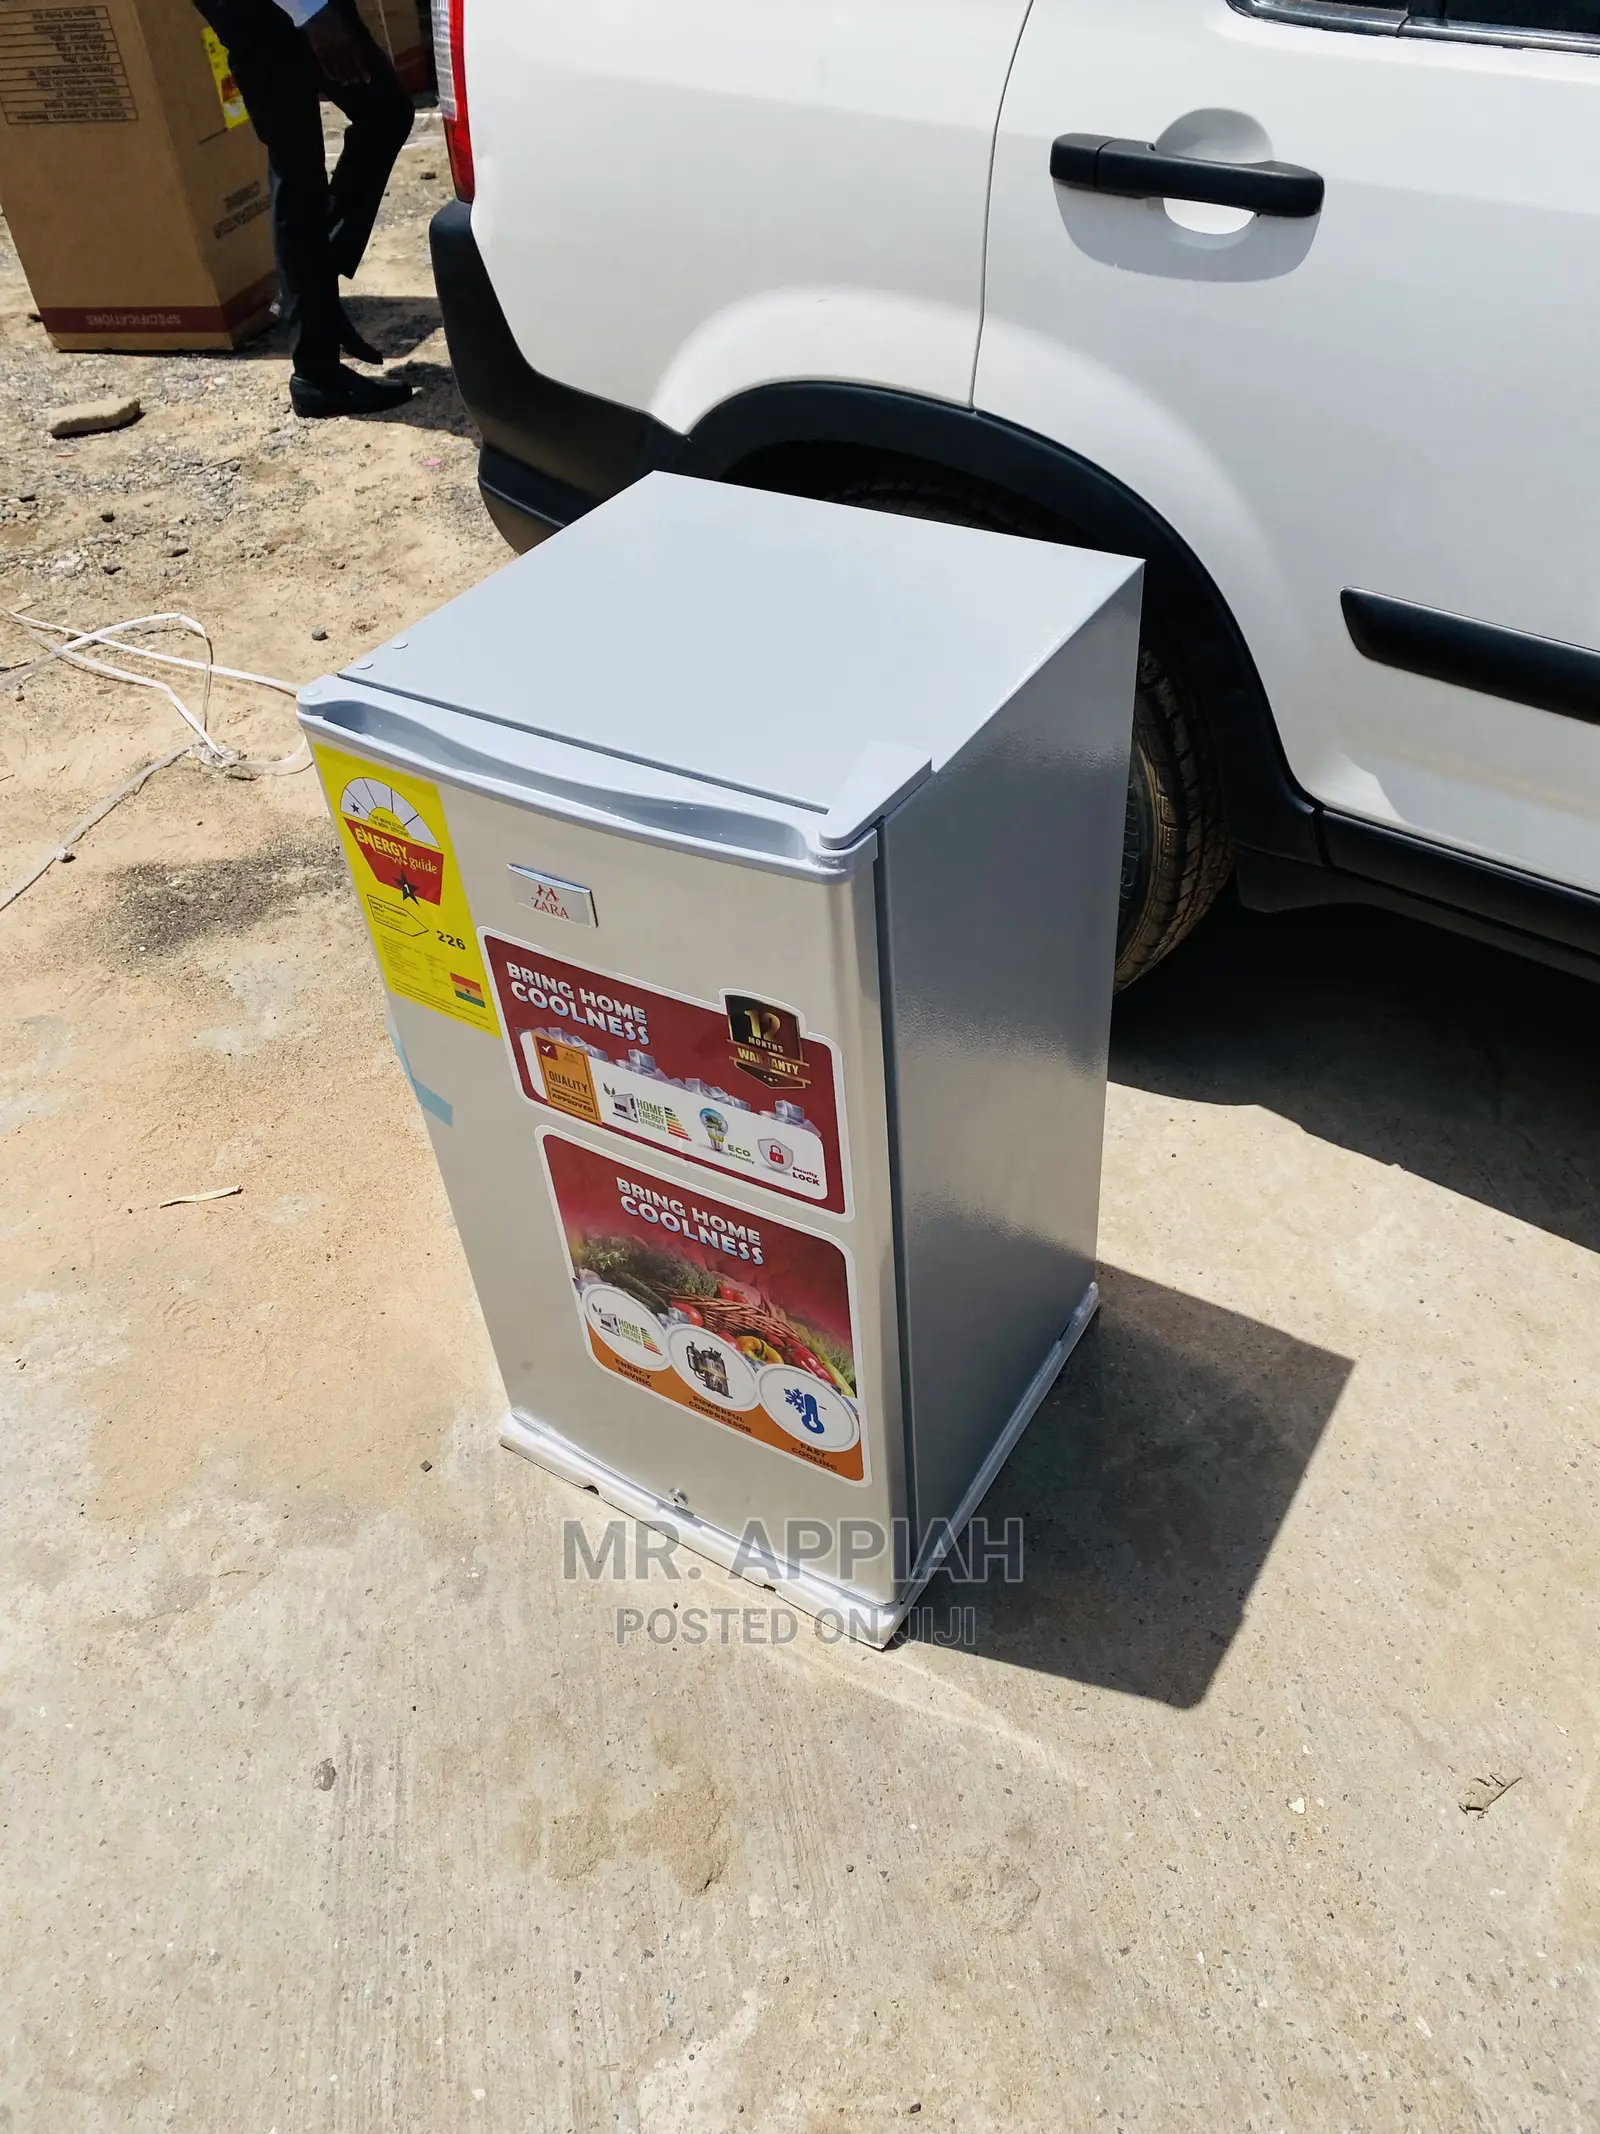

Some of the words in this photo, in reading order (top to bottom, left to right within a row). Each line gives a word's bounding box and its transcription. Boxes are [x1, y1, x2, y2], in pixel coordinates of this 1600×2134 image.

[86, 314, 181, 327] SPECIFICATIONS
[354, 826, 408, 860] ENERGY
[409, 857, 438, 874] guide
[531, 897, 569, 919] ZARA
[436, 930, 466, 950] 226
[505, 961, 575, 1000] BRING
[579, 987, 648, 1025] HOME
[510, 981, 649, 1045] COOLNESS
[744, 1009, 781, 1041] 12
[748, 1036, 784, 1053] MONTHS
[548, 1070, 588, 1093] QUALITY
[552, 1092, 594, 1113] APPROVED
[636, 1098, 664, 1116] HOME
[638, 1111, 665, 1125] ENERGY
[727, 1144, 751, 1157] ECO
[792, 1172, 820, 1186] LOCK
[616, 1177, 686, 1218] BRING
[692, 1207, 760, 1246] HOME
[620, 1195, 764, 1265] COOLNESS
[618, 1318, 640, 1334] HOME
[688, 1401, 752, 1433] COMPRESSOR
[791, 1447, 837, 1470] COOLING
